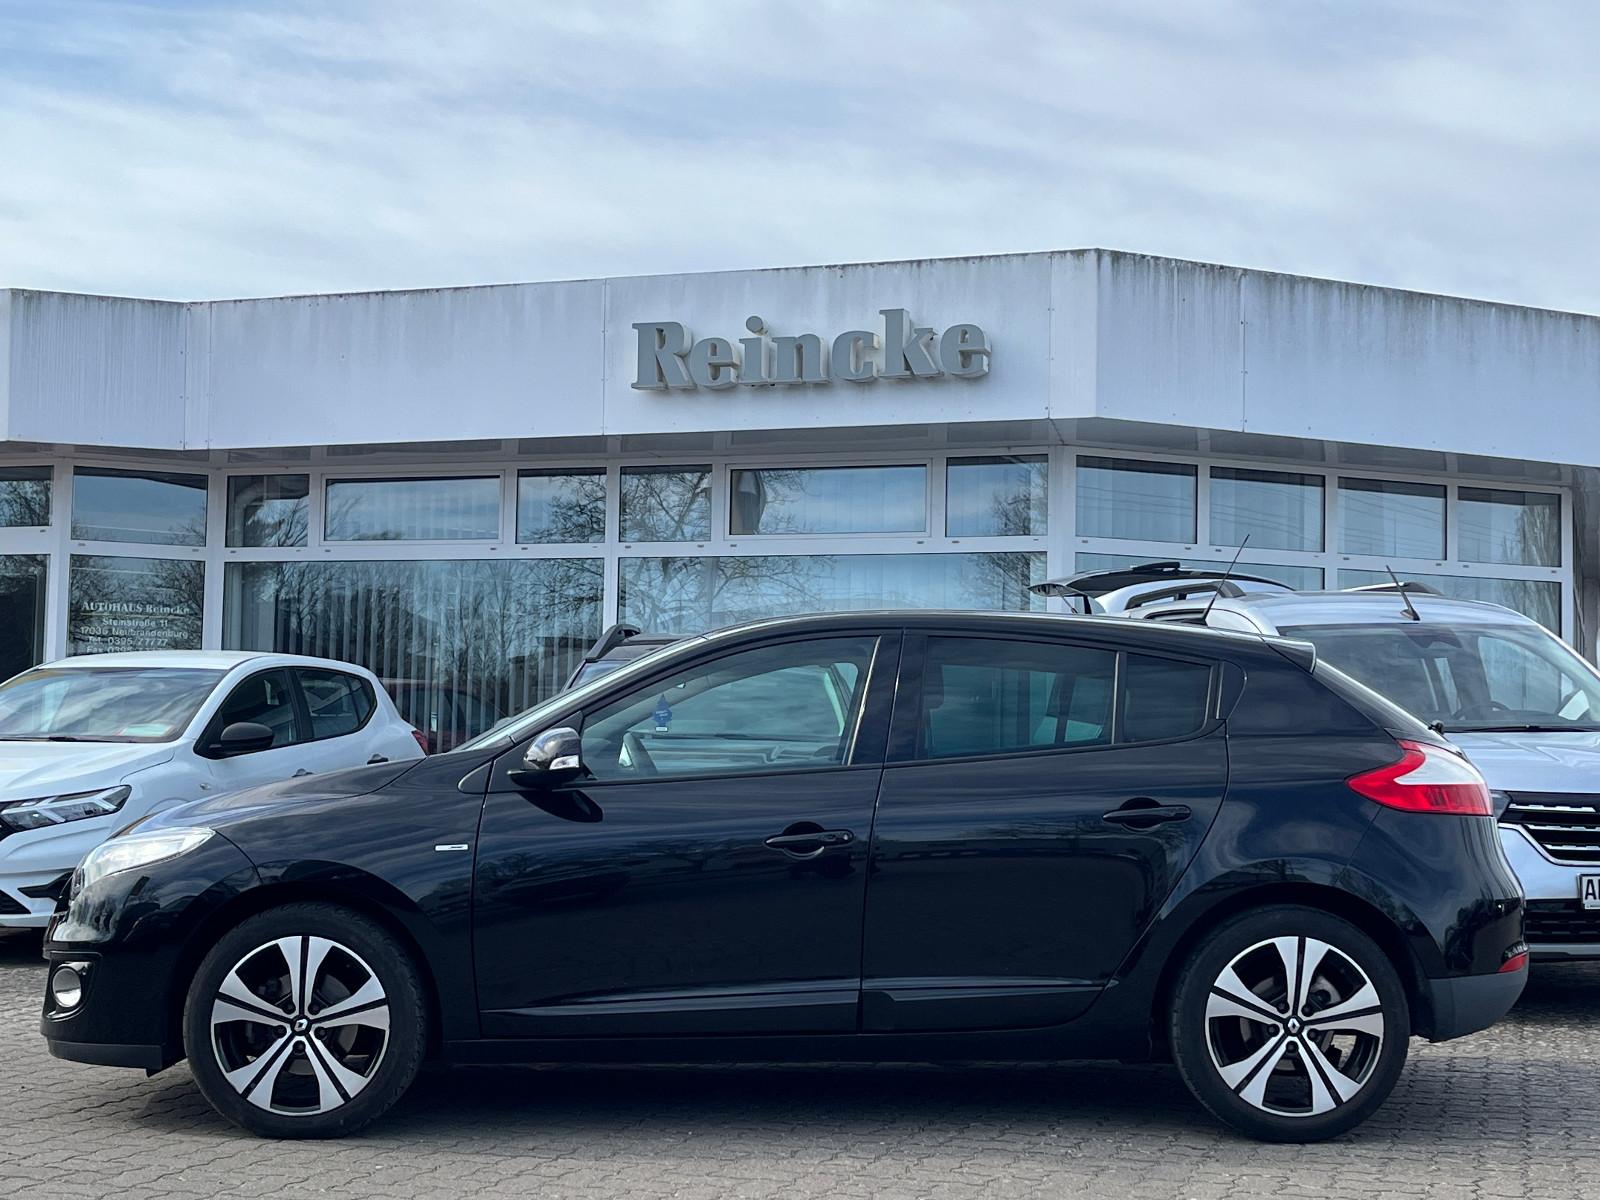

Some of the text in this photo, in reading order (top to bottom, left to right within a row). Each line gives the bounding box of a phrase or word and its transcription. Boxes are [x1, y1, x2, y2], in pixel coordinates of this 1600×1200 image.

[631, 308, 992, 390] Reincke
[81, 601, 143, 613] AUTOHAUS
[111, 627, 189, 639] Neubrandenburg
[1585, 878, 1600, 900] A
